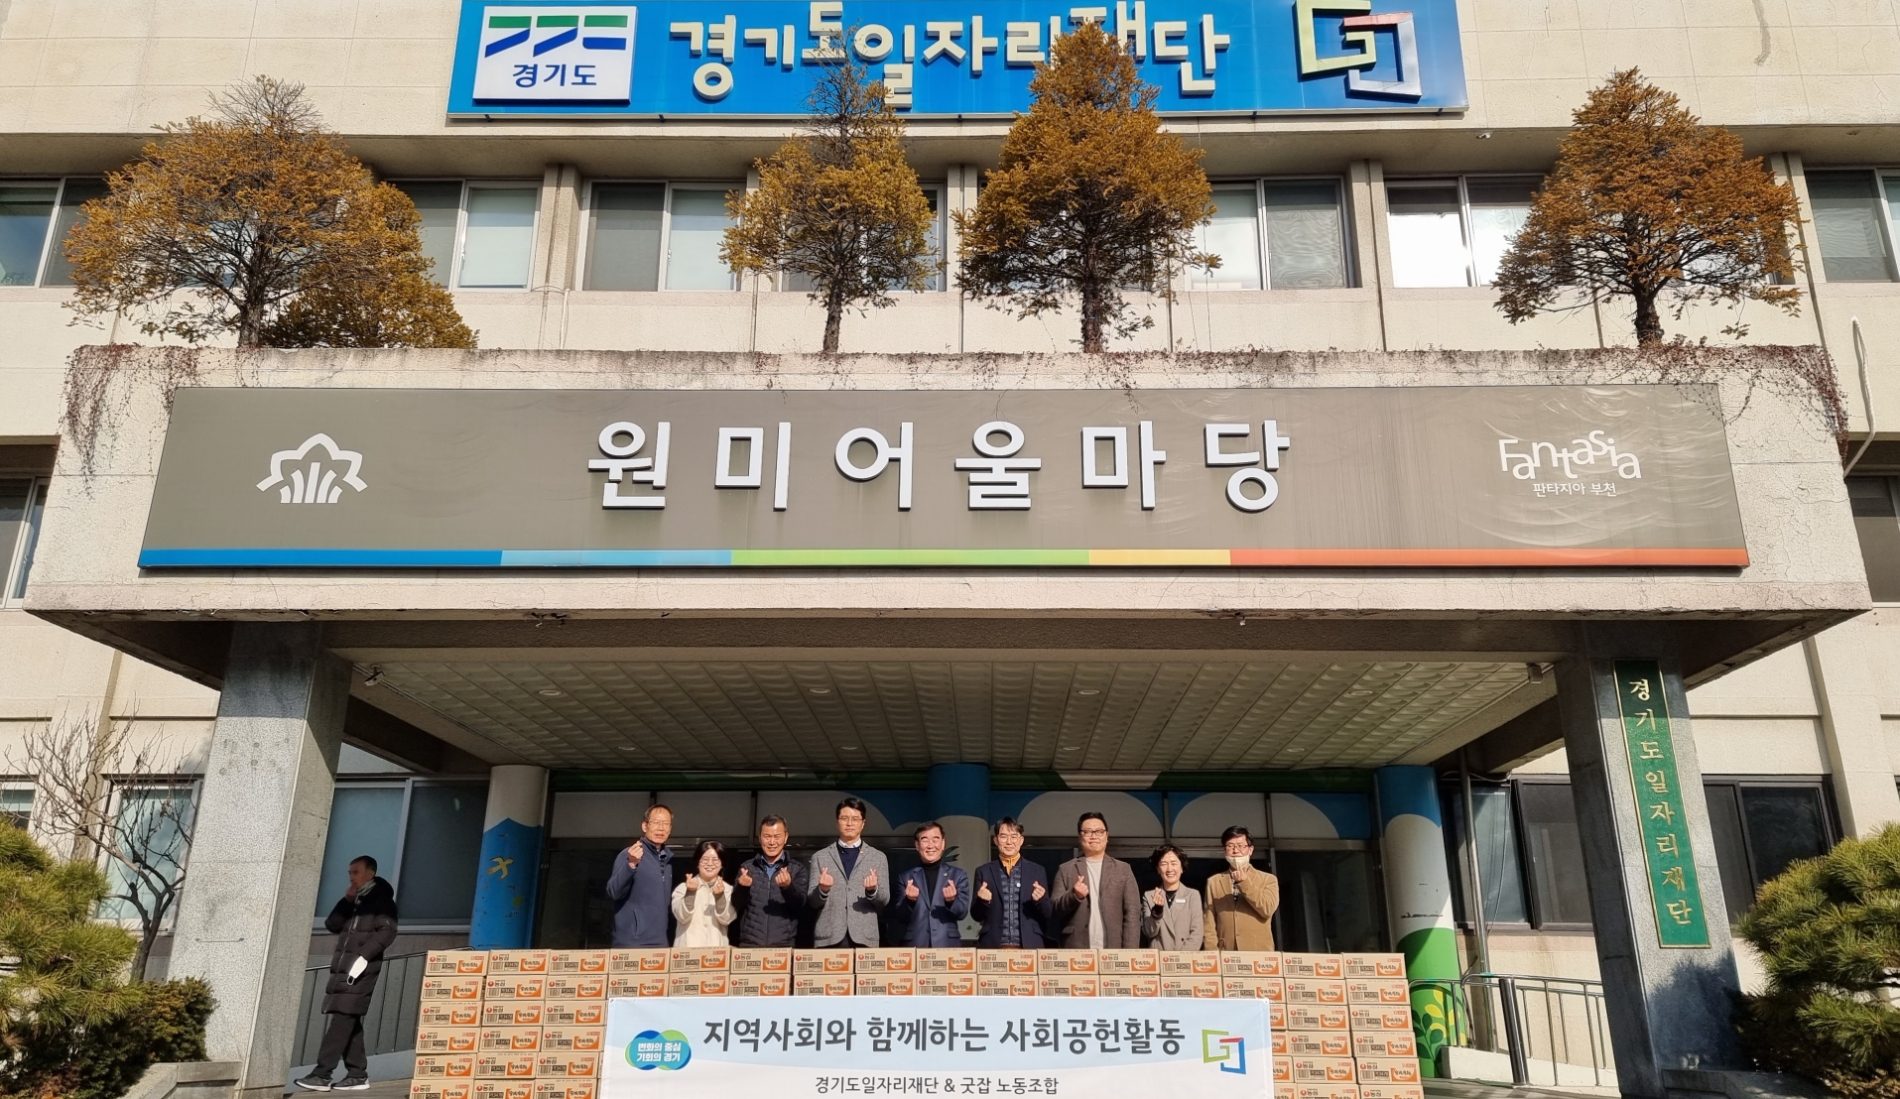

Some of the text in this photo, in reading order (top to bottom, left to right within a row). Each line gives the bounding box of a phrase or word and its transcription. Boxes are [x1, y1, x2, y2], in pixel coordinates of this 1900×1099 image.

[670, 1, 1230, 108] 경기도일자리재단
[512, 63, 597, 88] 경기도
[587, 420, 1290, 512] 원미어울마당
[1498, 430, 1642, 479] Fantasia
[1532, 482, 1617, 497] 판타지아 부천
[1628, 678, 1693, 925] 경기도일자리재단
[637, 1042, 682, 1052] 변화의 중심
[703, 1016, 1186, 1056] 지역사회와 함께하는 사회공헌활동
[636, 1052, 681, 1062] 기회의 경기
[815, 1076, 1059, 1095] 경기도일자리재단 & 굿잡 노동조합
